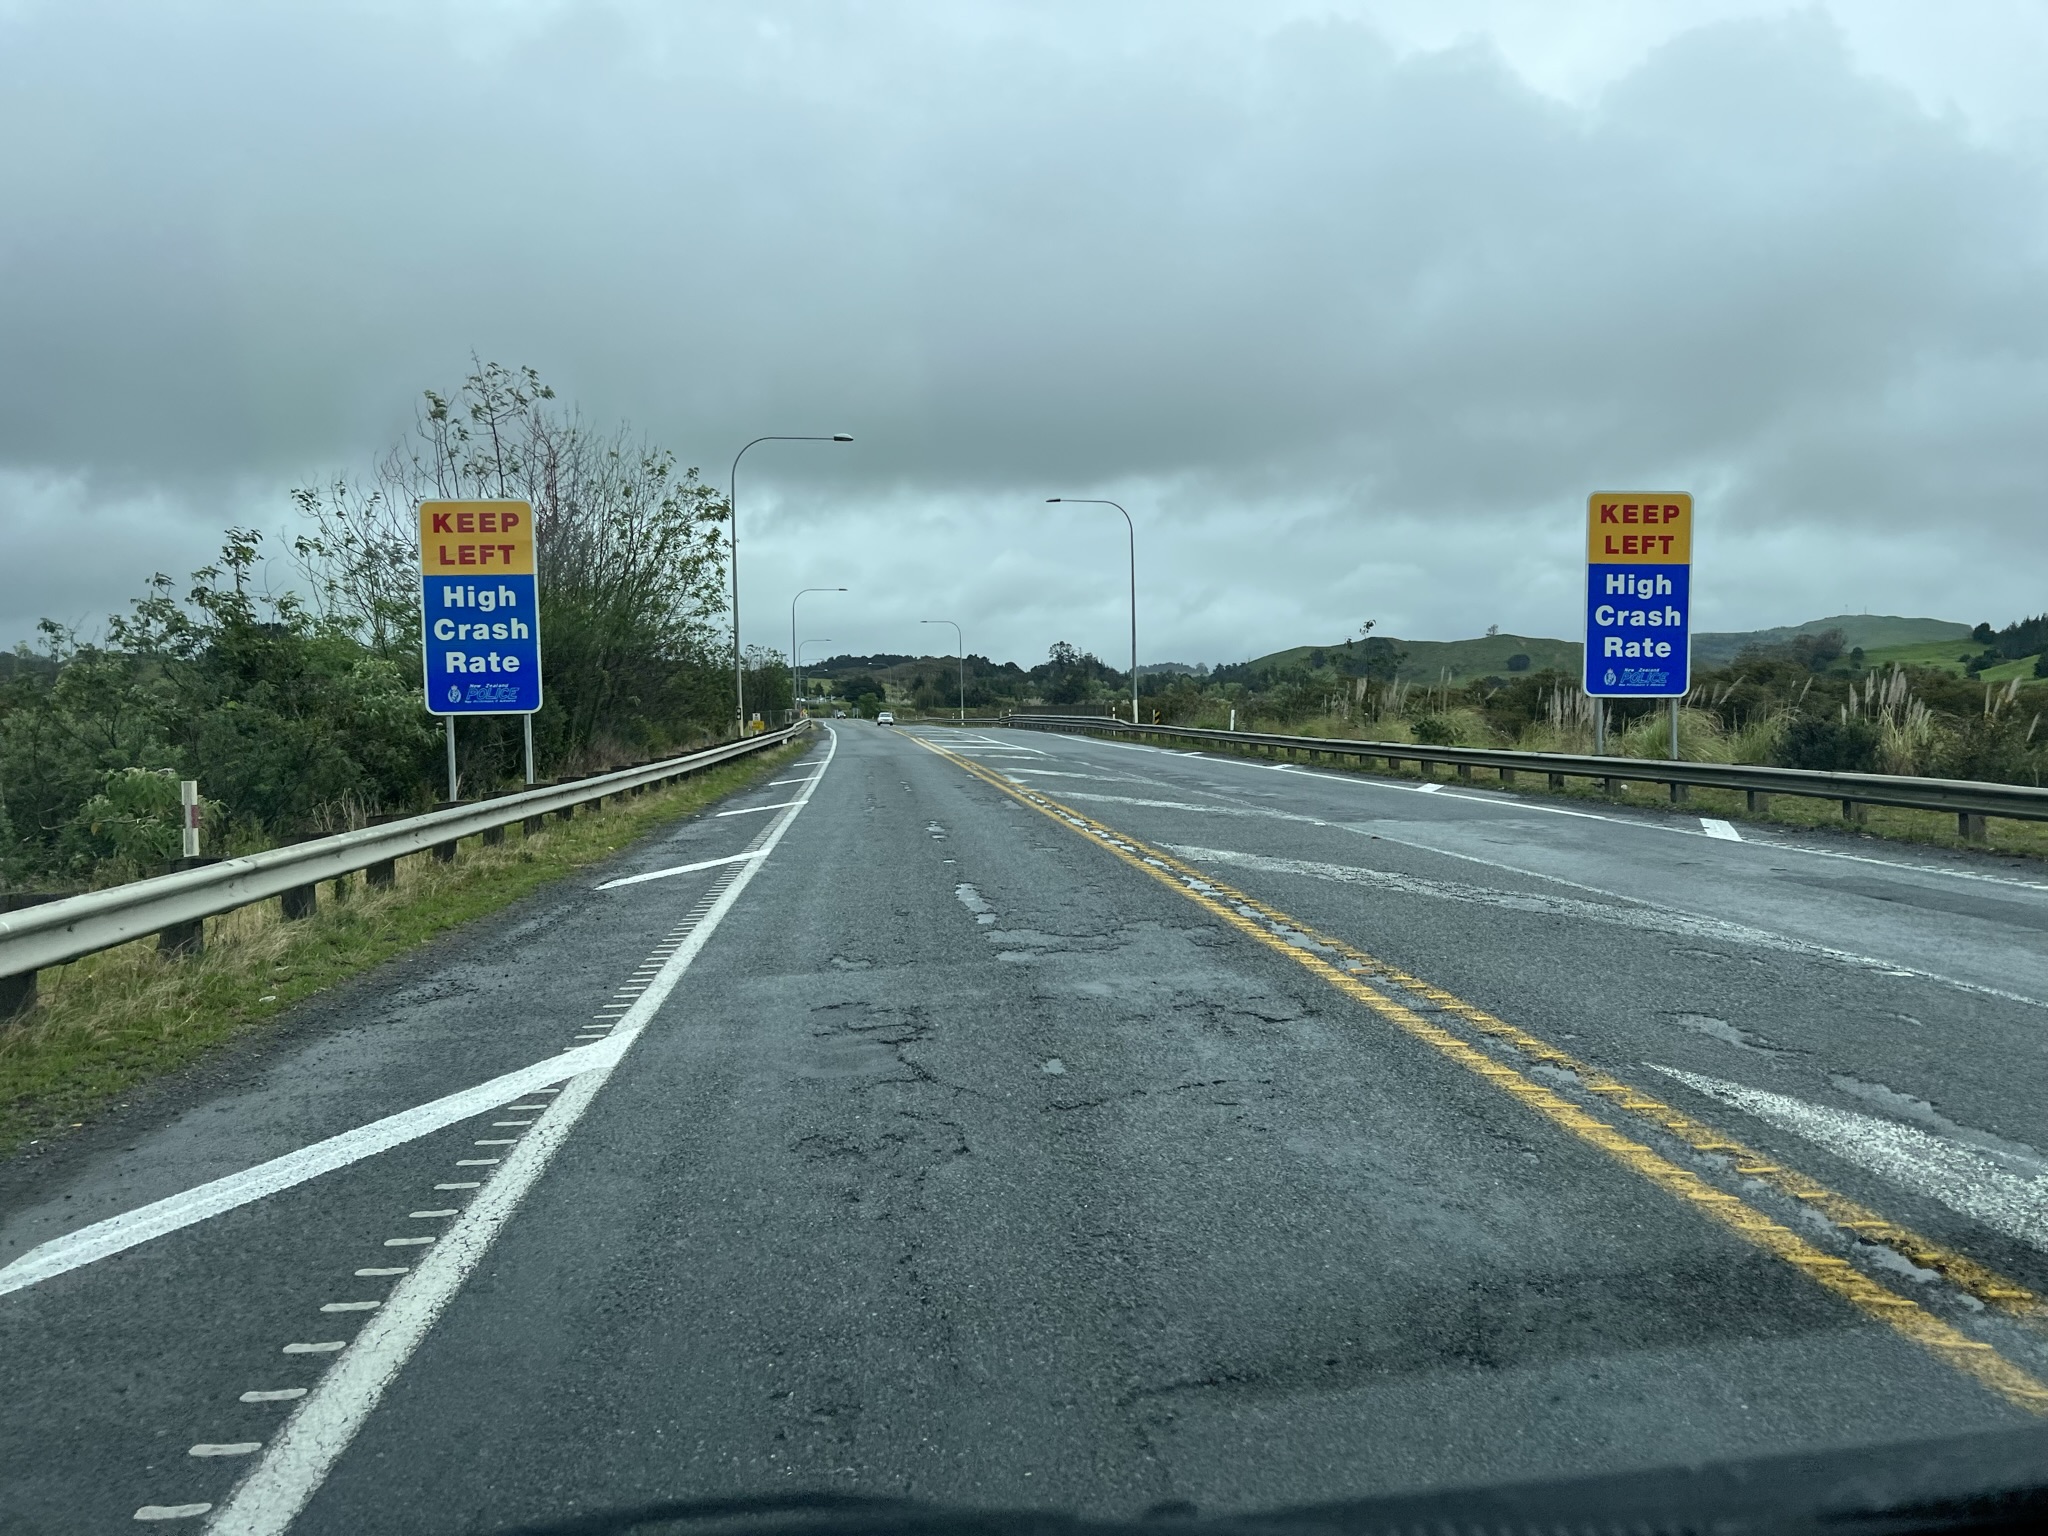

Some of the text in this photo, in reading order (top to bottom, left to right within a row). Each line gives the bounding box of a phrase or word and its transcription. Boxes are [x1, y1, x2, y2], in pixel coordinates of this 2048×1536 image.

[433, 513, 519, 533] KEEP
[1601, 504, 1679, 524] KEEP
[1605, 535, 1674, 554] LEFT
[440, 545, 515, 565] LEFT
[1606, 574, 1672, 599] High
[443, 585, 517, 612] High
[1595, 605, 1681, 626] Crash
[433, 617, 529, 640] Crash
[1604, 637, 1671, 658] Rate
[446, 651, 520, 673] Rate
[1620, 672, 1669, 684] POLICE
[466, 687, 520, 700] POLICE
